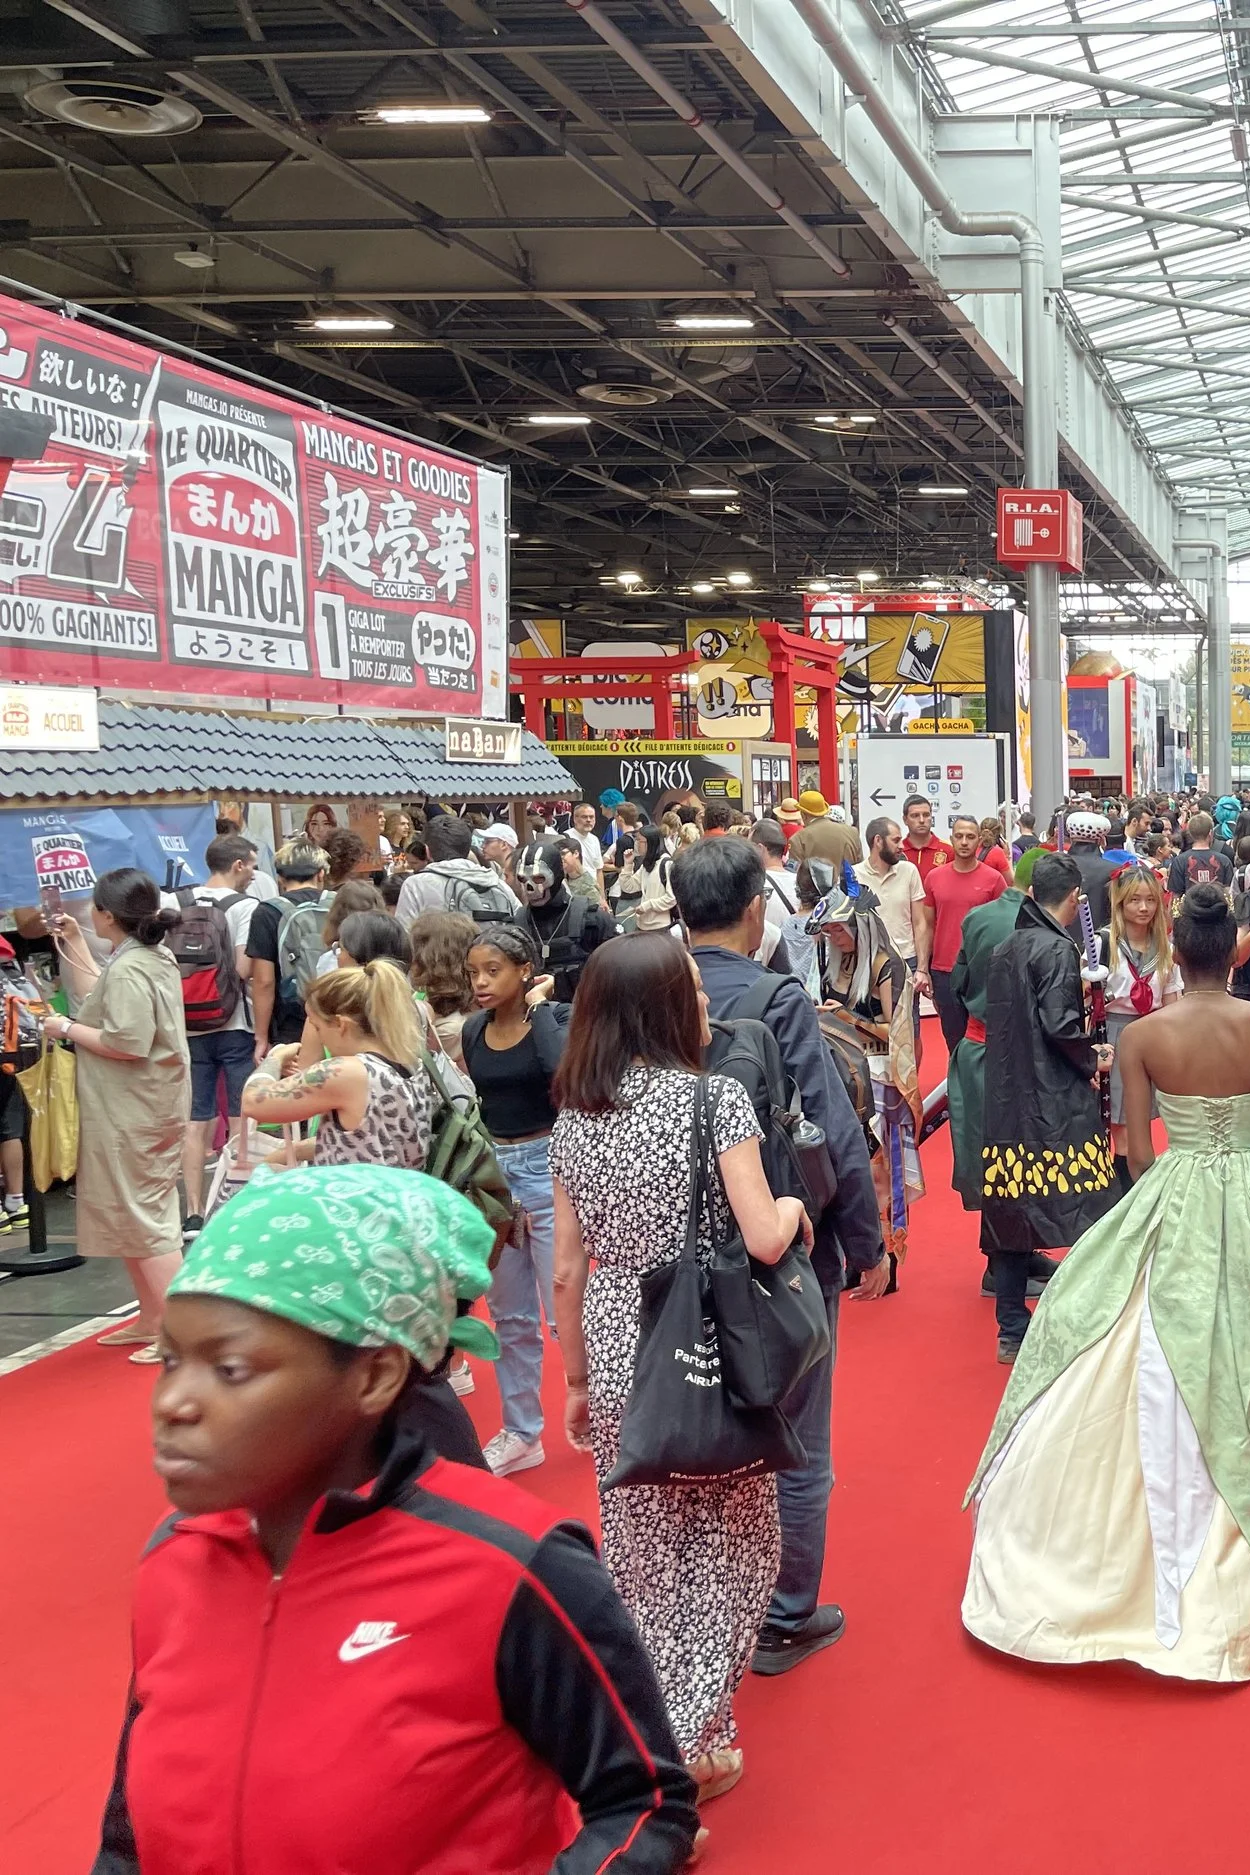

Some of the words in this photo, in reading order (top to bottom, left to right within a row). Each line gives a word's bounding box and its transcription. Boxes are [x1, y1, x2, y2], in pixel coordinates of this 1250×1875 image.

[186, 388, 228, 417] MANGAS.IO
[229, 404, 268, 430] PRÉSENTE
[165, 426, 189, 468] LE
[195, 424, 294, 502] QUARTIER
[301, 420, 379, 476] MANGAS
[382, 447, 403, 483] ET
[408, 457, 472, 505] GOODIES
[1005, 502, 1059, 513] R.I.A.
[317, 471, 475, 603] 超豪華
[173, 541, 301, 626] MANGA
[373, 582, 435, 601] EXCLUSIFS!
[52, 606, 154, 648] GAGNANTS!
[349, 610, 369, 631] GIGA
[370, 612, 386, 633] LOT
[350, 630, 358, 653] À
[358, 636, 406, 660] REMPORTER
[352, 659, 374, 679] TOUS
[373, 662, 388, 680] LES
[388, 663, 413, 683] JOURS
[43, 712, 85, 732] ACCUEIL
[578, 743, 608, 752] DÉDICACE
[645, 743, 658, 751] FILE
[660, 743, 690, 752] D'ATTENTE
[693, 742, 724, 751] DÉDICACE
[41, 868, 96, 893] MANGA
[720, 1472, 730, 1480] IN
[749, 1458, 765, 1470] AIR
[350, 1621, 398, 1644] NIKE
